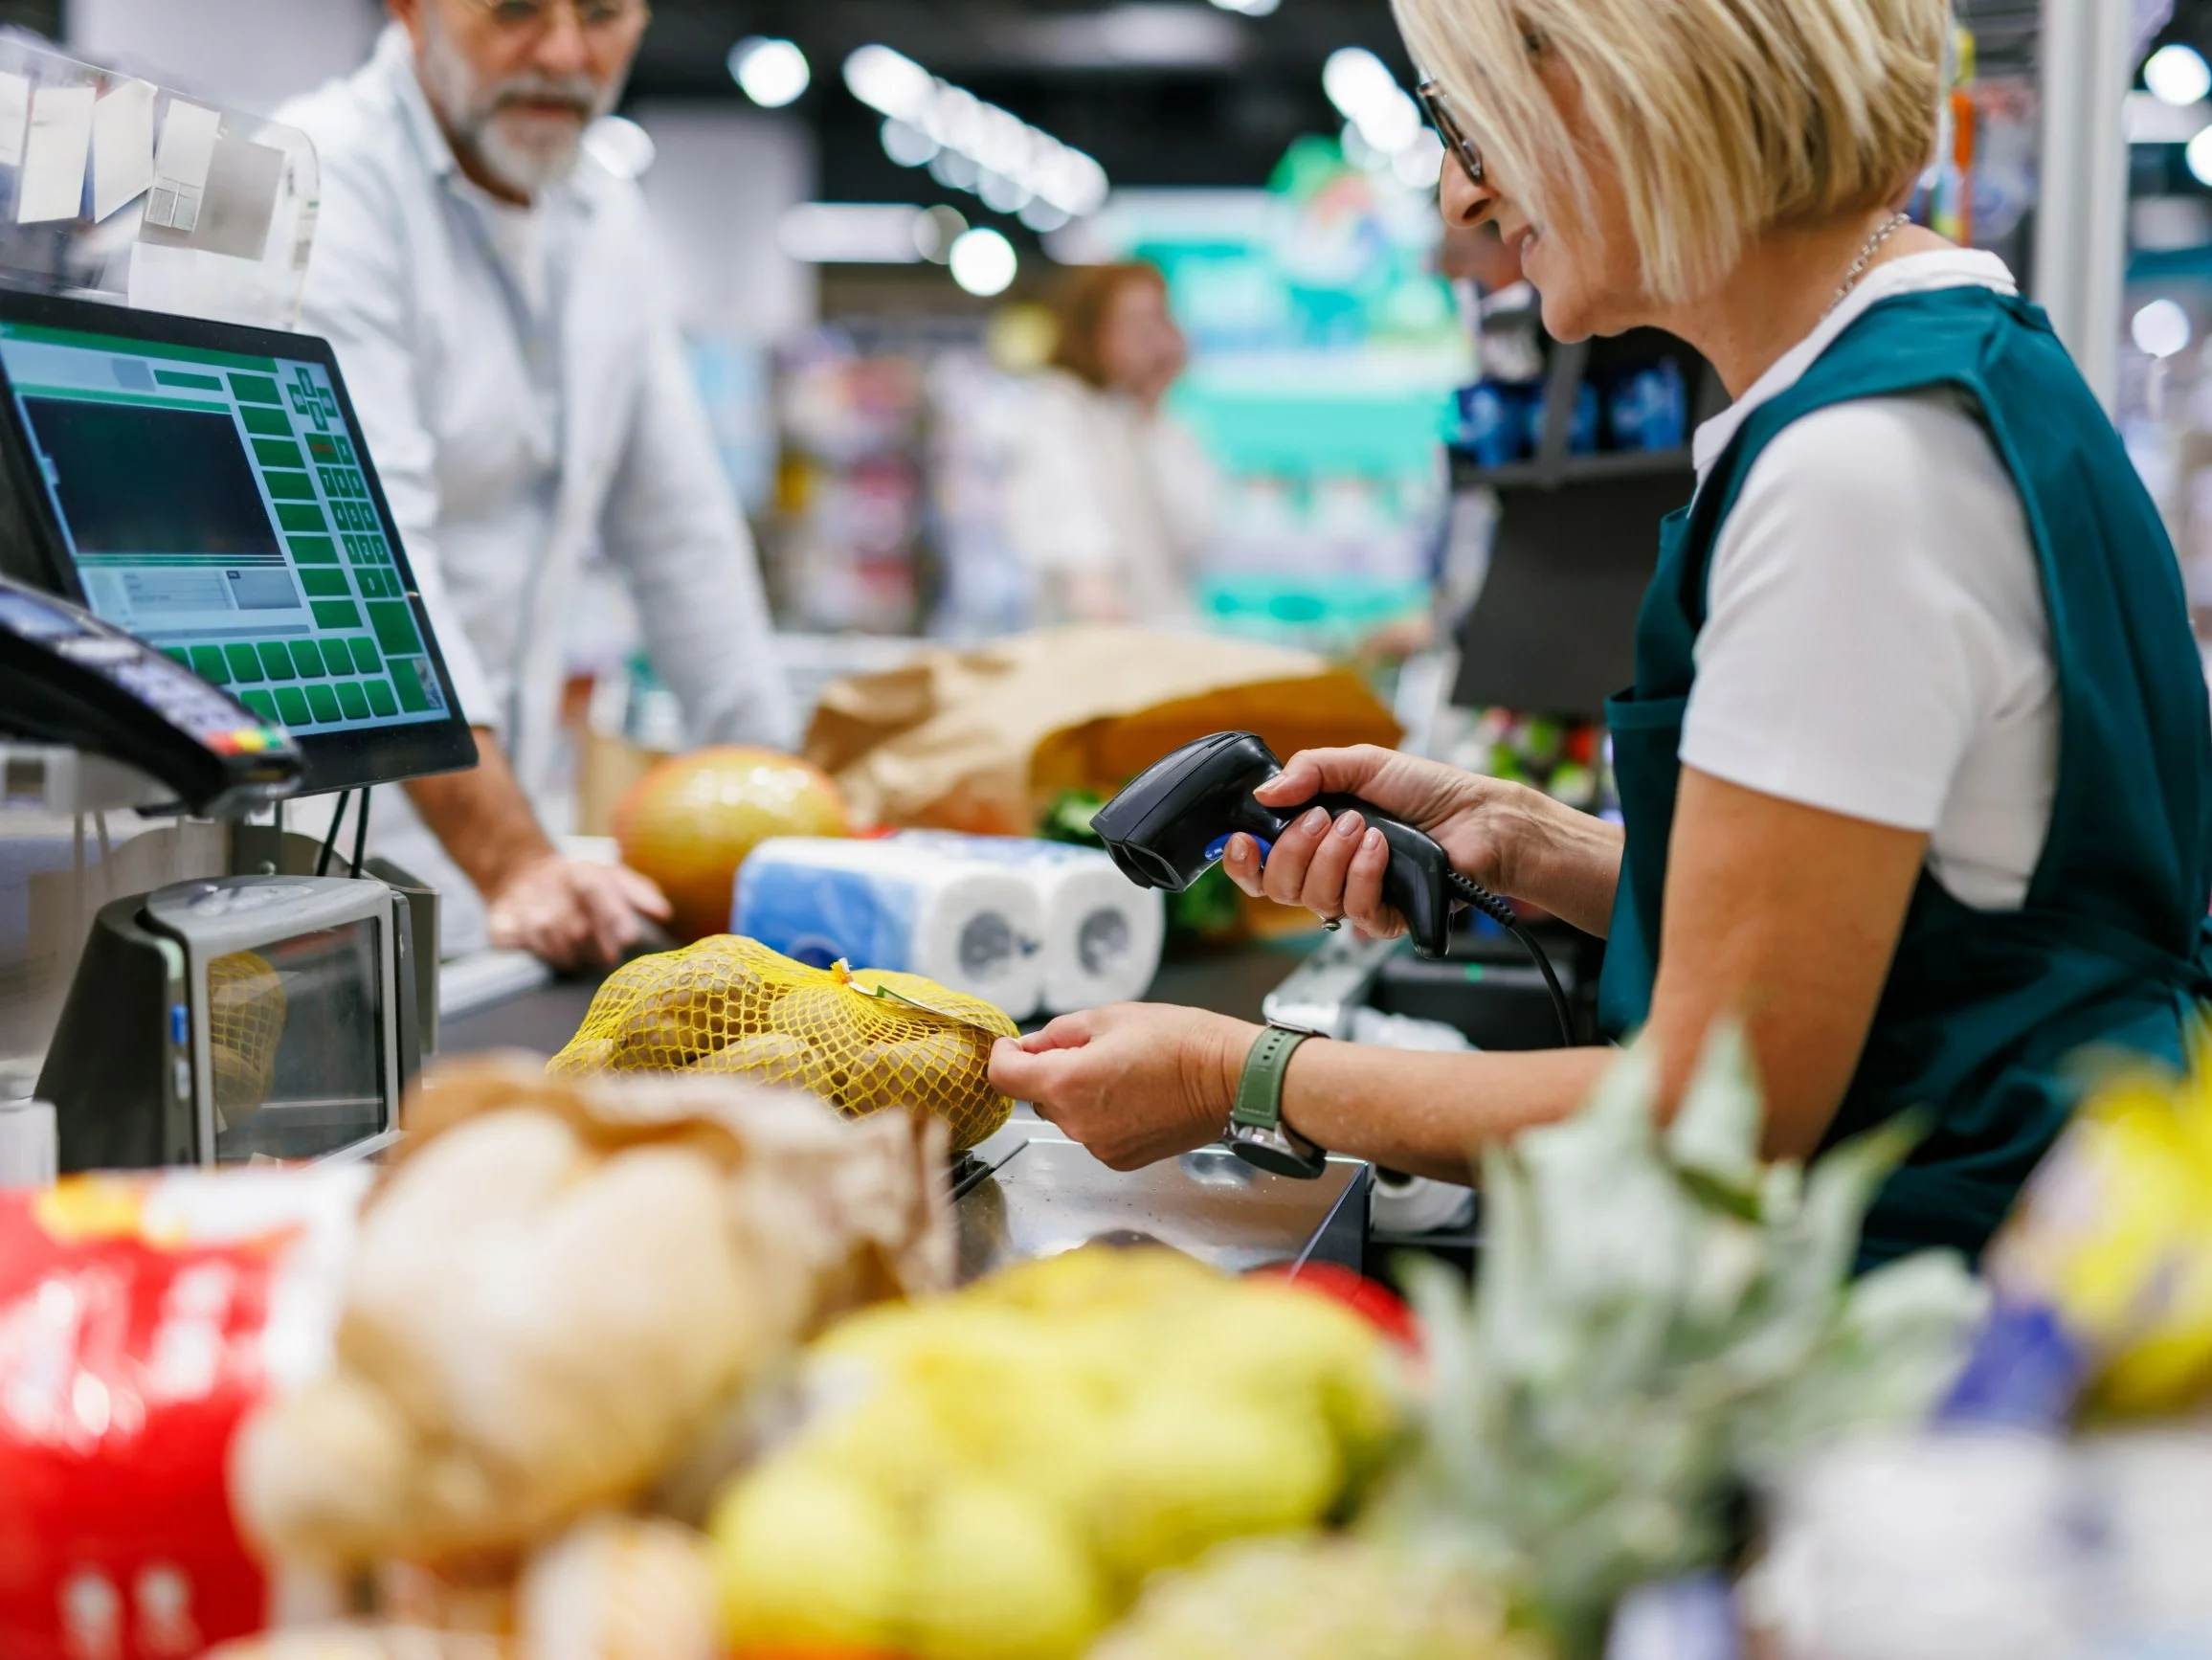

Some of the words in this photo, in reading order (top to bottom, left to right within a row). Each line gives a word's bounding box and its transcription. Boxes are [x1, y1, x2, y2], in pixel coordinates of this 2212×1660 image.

[323, 474, 330, 488] 7
[337, 508, 344, 522] 4
[348, 542, 355, 555] 1
[362, 542, 370, 555] 2
[376, 542, 384, 555] 3
[368, 577, 375, 591] 0
